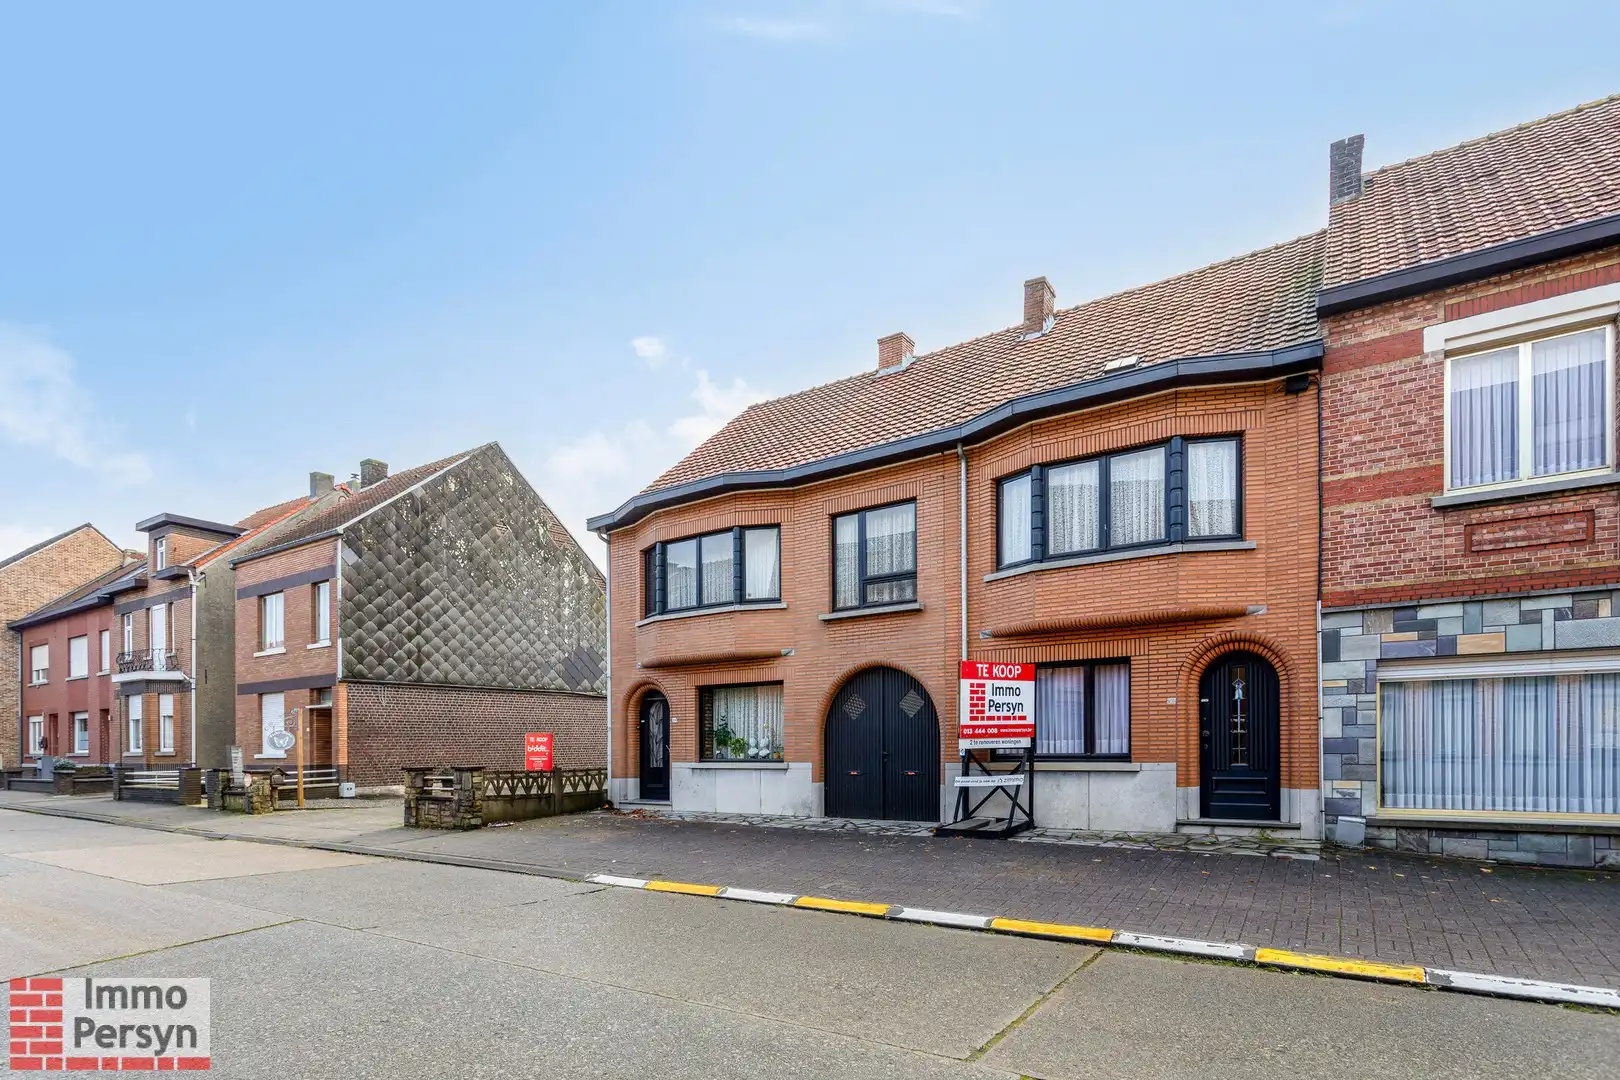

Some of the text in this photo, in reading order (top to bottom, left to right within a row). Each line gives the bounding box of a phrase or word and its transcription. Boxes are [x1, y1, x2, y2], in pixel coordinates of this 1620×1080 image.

[976, 664, 1022, 678] TE KOOP
[991, 683, 1021, 696] Immo
[988, 699, 1024, 715] Persyn
